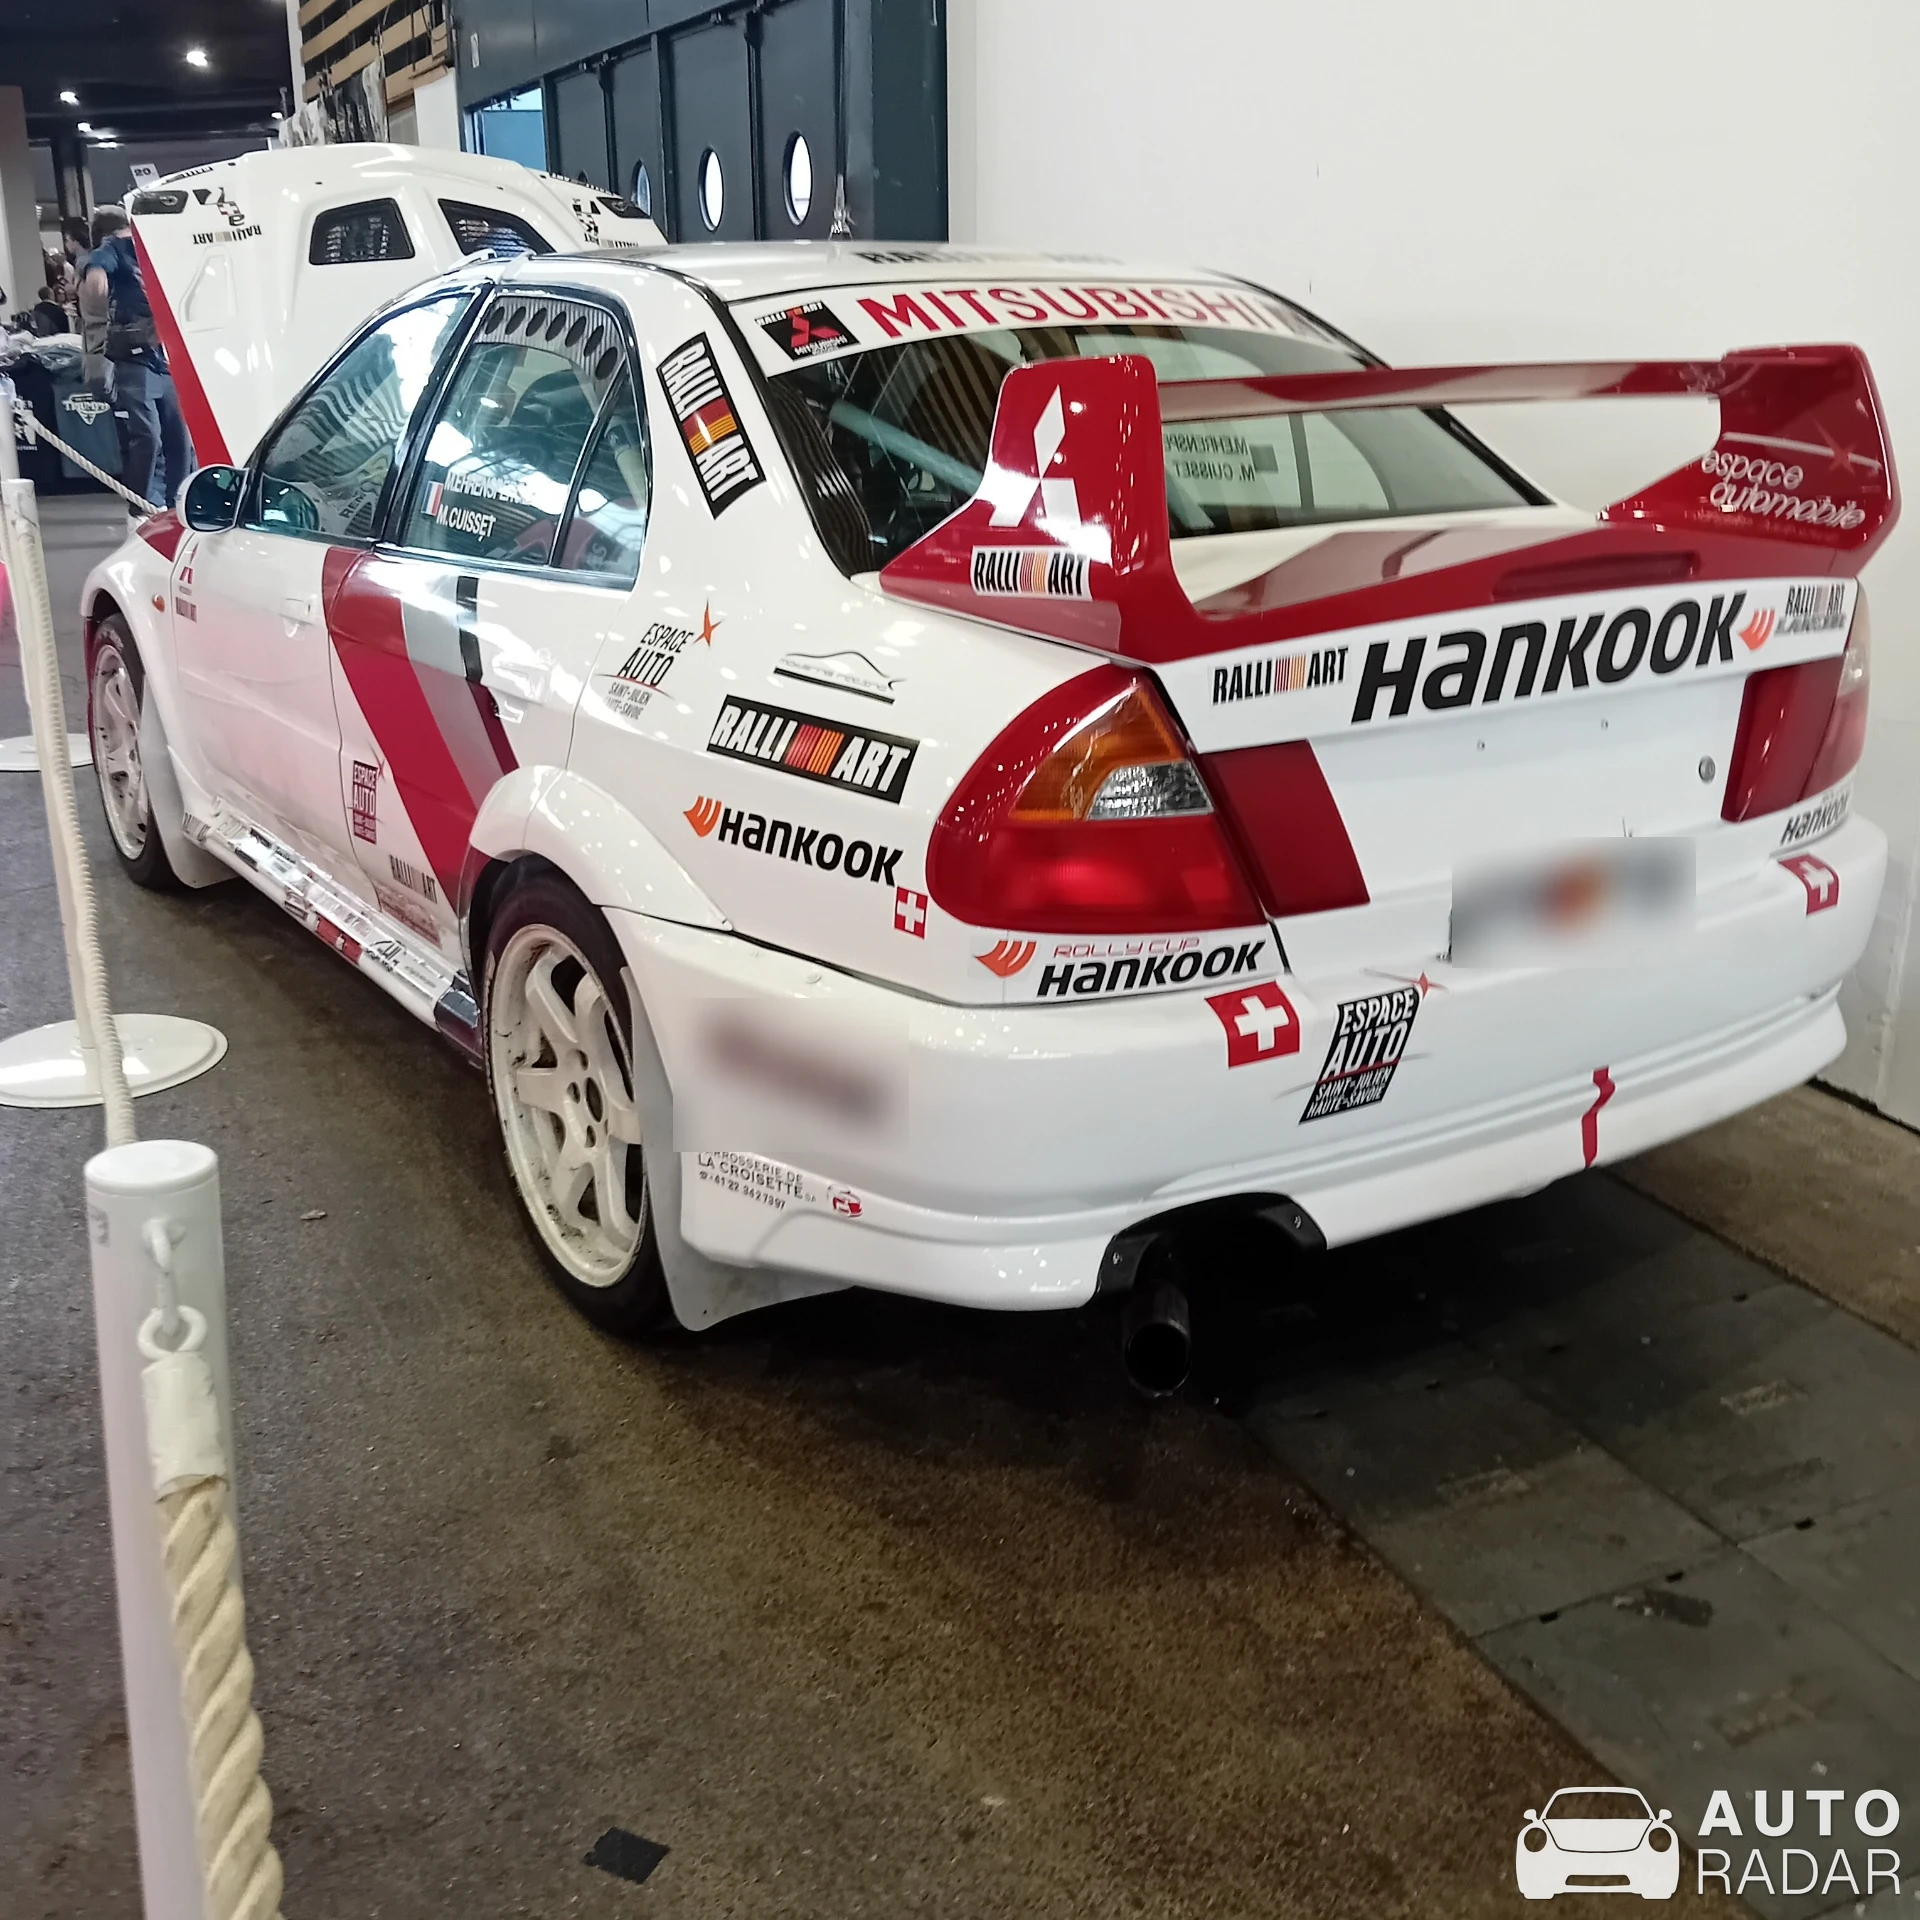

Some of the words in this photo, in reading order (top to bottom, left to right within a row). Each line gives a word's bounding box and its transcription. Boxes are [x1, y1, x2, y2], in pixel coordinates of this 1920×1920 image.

[134, 168, 151, 176] 20
[193, 232, 214, 244] ART
[802, 301, 824, 314] ART
[856, 288, 1276, 339] MITSUBISHI
[661, 341, 724, 422] RALLI
[695, 433, 759, 502] ART
[1702, 450, 1804, 490] espace
[1710, 482, 1866, 530] automobile
[974, 551, 1021, 593] RALLI
[1047, 553, 1087, 597] ART
[1785, 585, 1816, 617] RALLI
[640, 622, 695, 653] ESPACE
[617, 646, 675, 688] AUTO
[1212, 658, 1272, 706] RALLI
[1307, 647, 1350, 689] ART
[709, 704, 799, 763] RALLI
[830, 735, 911, 793] ART
[354, 764, 377, 788] ESPACE
[354, 786, 376, 816] AUTO
[1148, 937, 1200, 953] CUP
[1339, 988, 1414, 1037] ESPACE
[1321, 1020, 1408, 1081] AUTO
[1315, 1065, 1393, 1103] SAINT-JULIEN
[699, 1153, 716, 1170] LA
[719, 1161, 804, 1199] CROISETTE
[728, 1180, 740, 1193] 22
[787, 1171, 804, 1186] DE
